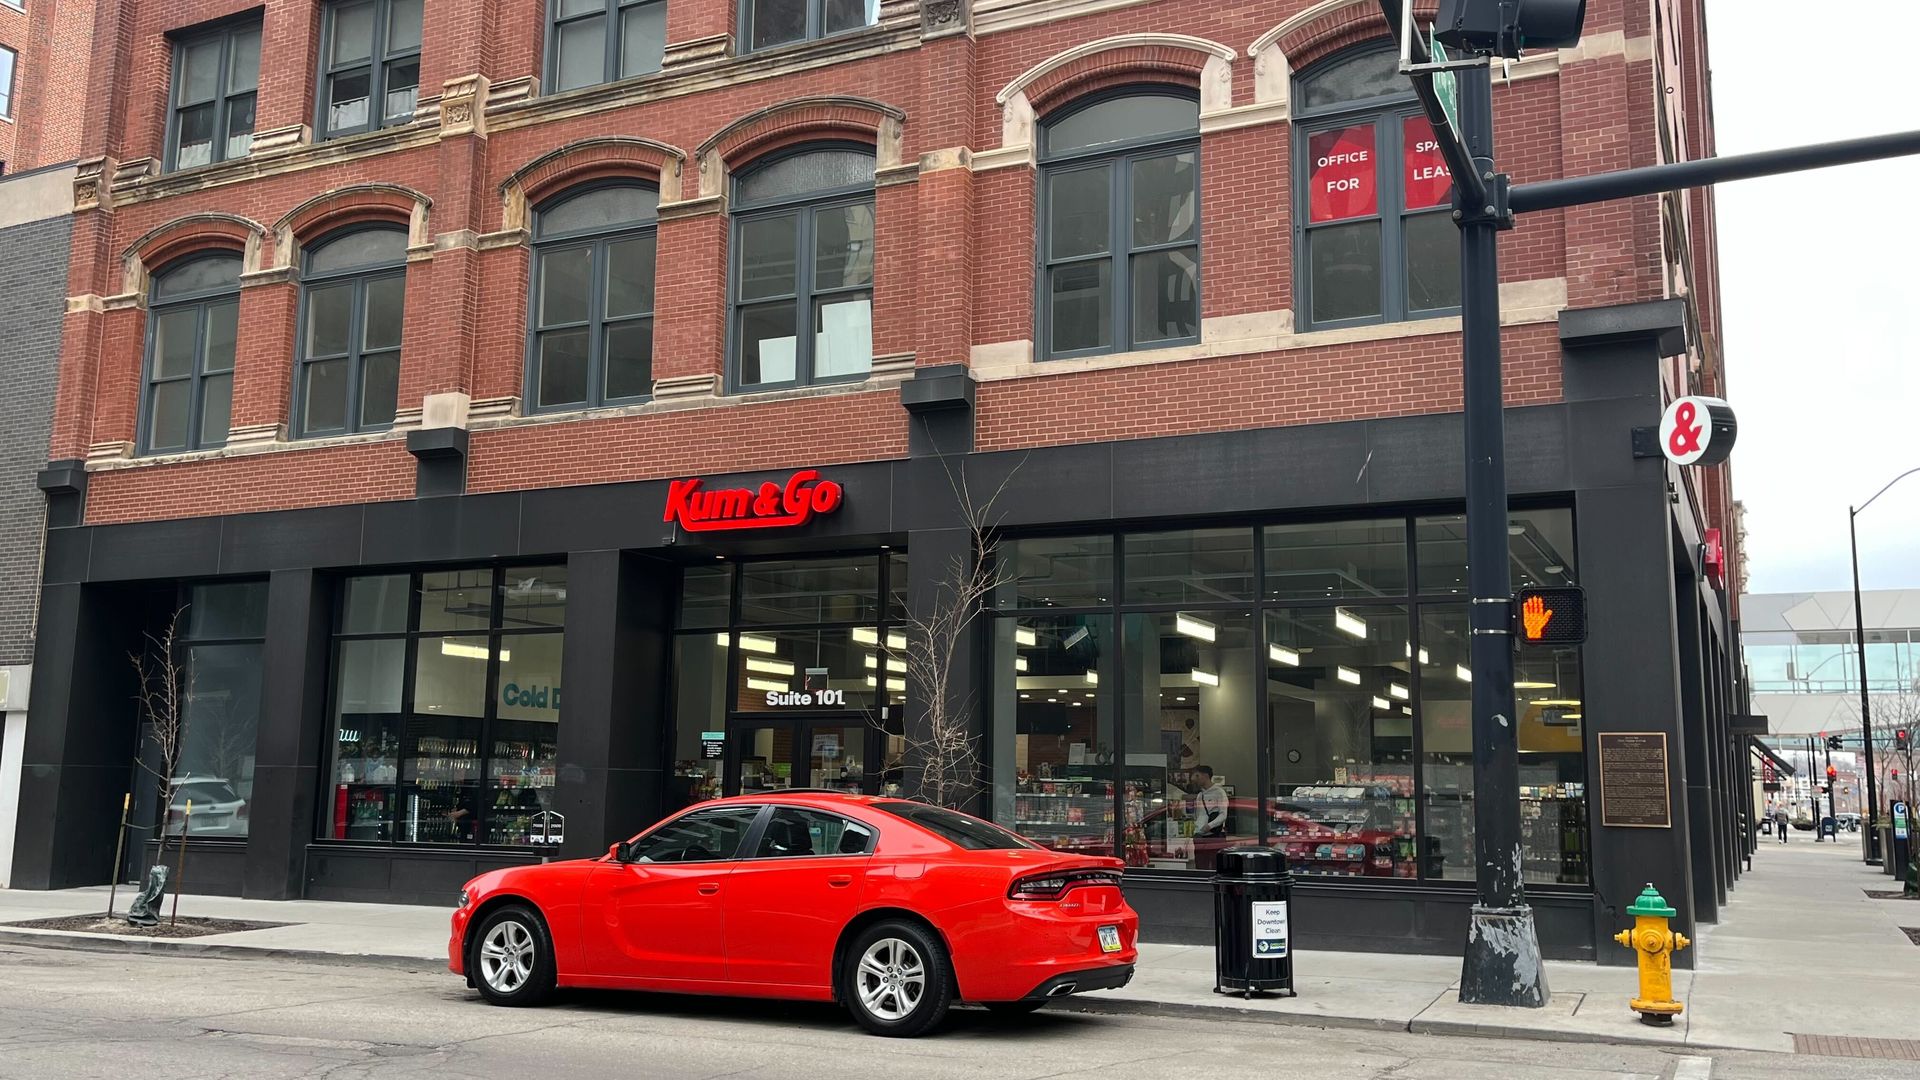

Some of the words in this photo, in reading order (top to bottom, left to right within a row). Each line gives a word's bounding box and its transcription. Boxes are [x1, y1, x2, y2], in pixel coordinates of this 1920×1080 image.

[1317, 150, 1368, 168] OFFICE
[1326, 177, 1360, 193] FOR
[1668, 401, 1703, 457] &
[503, 682, 549, 709] Cold
[765, 690, 812, 706] Suite
[815, 689, 846, 705] 101
